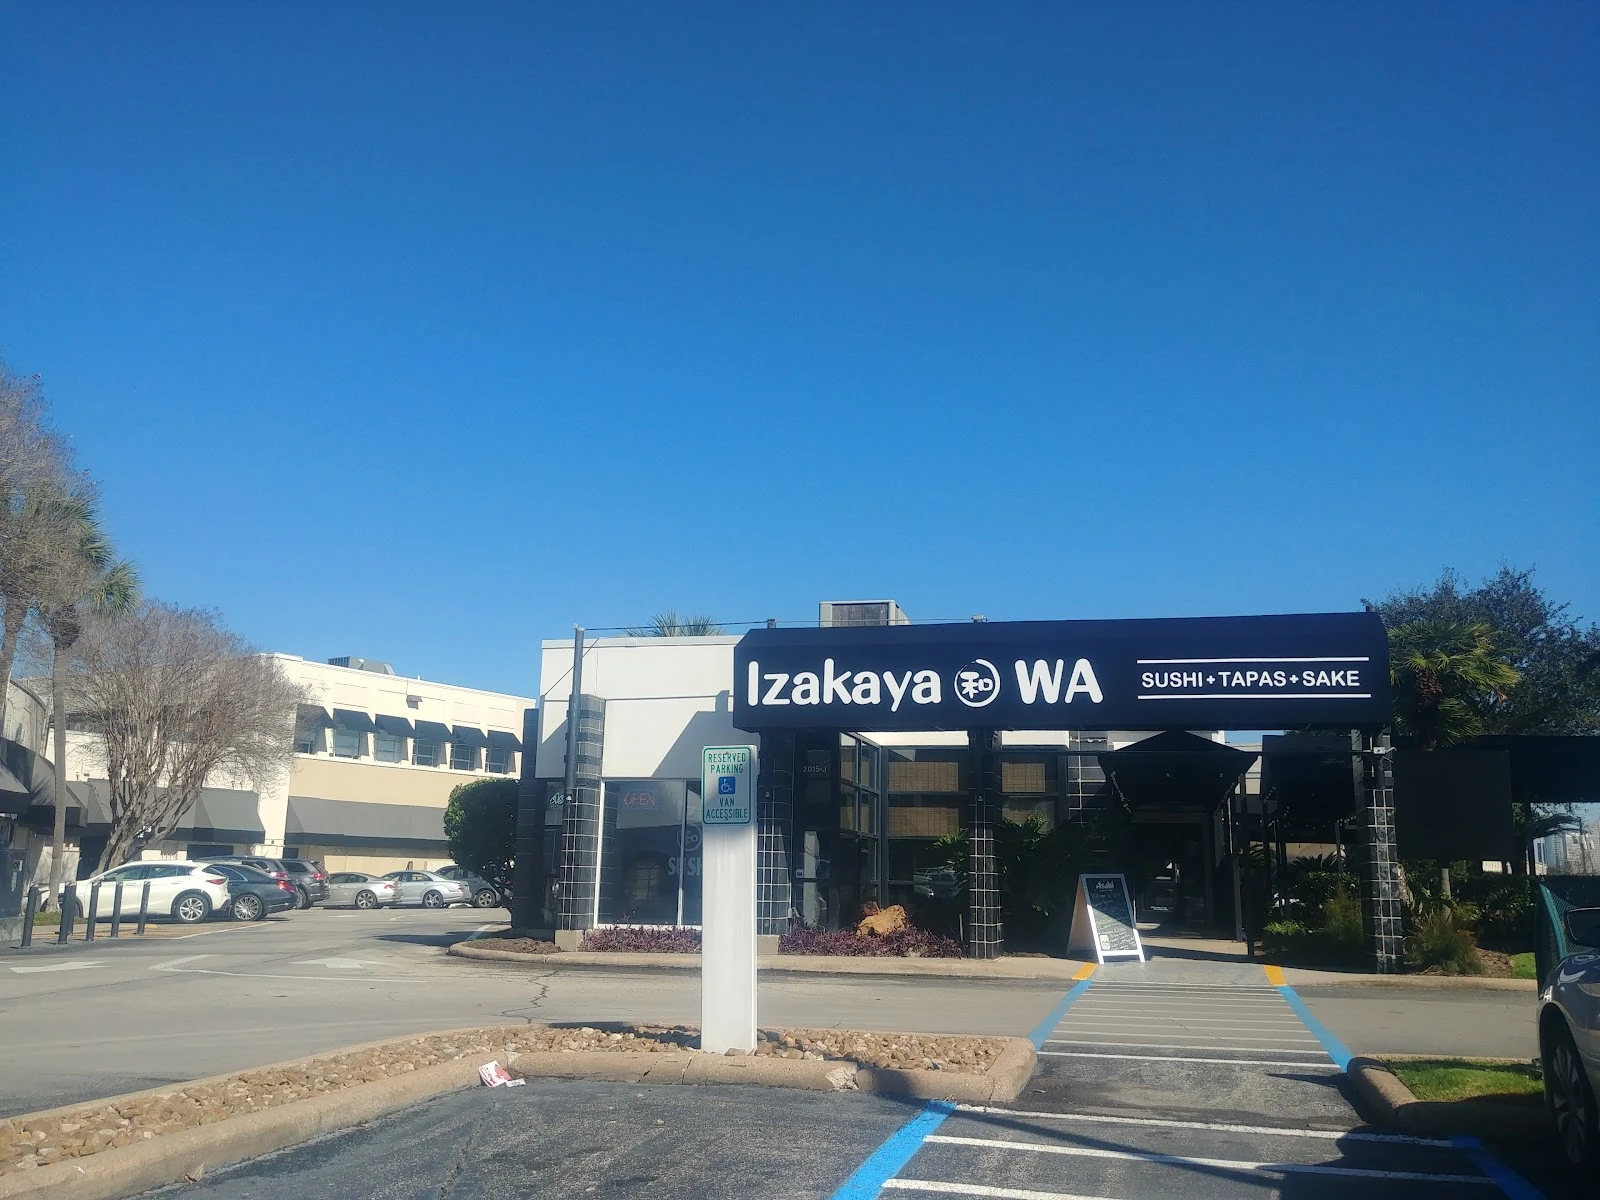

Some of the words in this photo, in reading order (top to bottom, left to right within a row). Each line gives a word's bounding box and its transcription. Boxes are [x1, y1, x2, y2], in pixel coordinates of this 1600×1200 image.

[1141, 671, 1203, 688] SUSHI
[1218, 671, 1287, 688] TAPAS
[1302, 670, 1361, 687] SAKE
[747, 658, 942, 713] Izakaya
[960, 671, 993, 699] 和
[1014, 658, 1104, 705] WA
[708, 752, 746, 763] RESERVED
[710, 764, 744, 774] PARKING
[625, 793, 656, 806] OPEN
[719, 797, 735, 807] VAN
[706, 808, 748, 819] ACCESSIBLE
